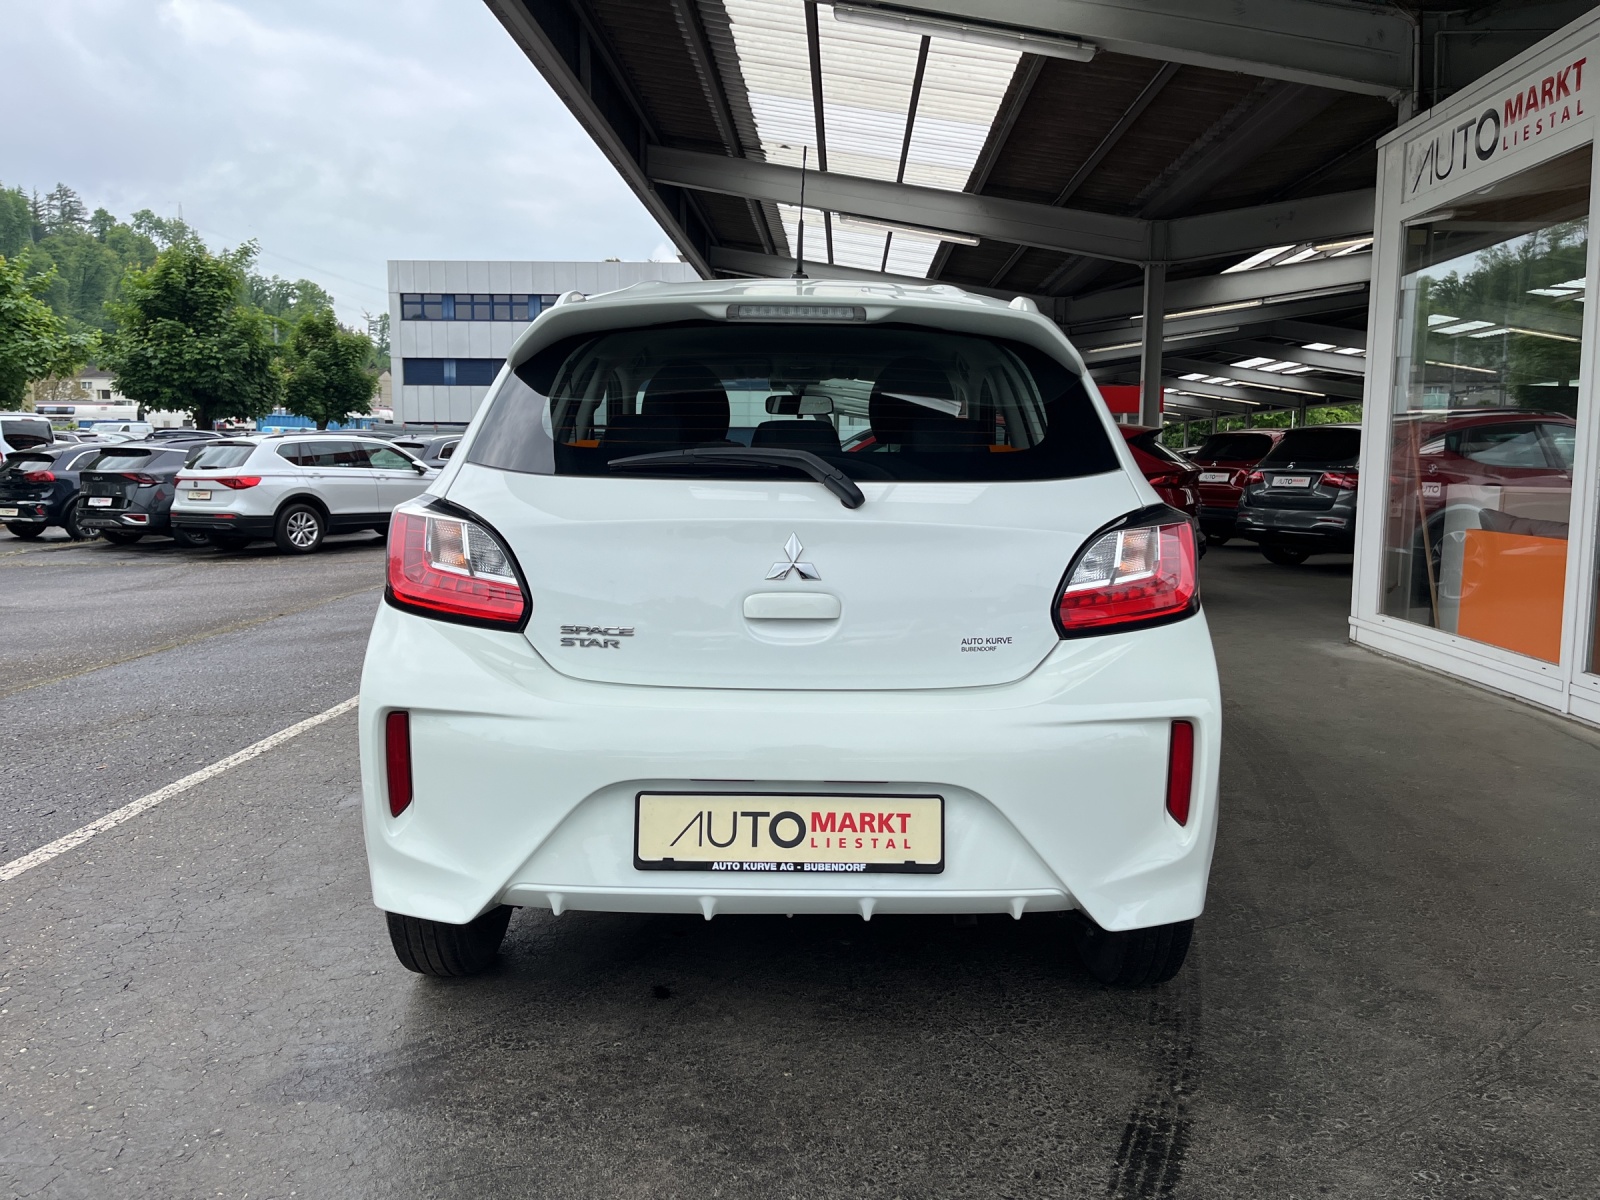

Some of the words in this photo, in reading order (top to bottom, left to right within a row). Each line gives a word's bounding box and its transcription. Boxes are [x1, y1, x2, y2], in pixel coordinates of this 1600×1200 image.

[1412, 108, 1501, 193] AUTO
[1503, 57, 1587, 128] MARKT
[1503, 99, 1584, 151] LIESTAL
[560, 625, 635, 637] SPACE
[560, 637, 620, 649] STAR
[669, 811, 806, 849] AUTO
[810, 811, 911, 834] MARKT
[810, 837, 911, 849] LIESTAL
[711, 862, 740, 871] AUTO
[742, 862, 777, 872] KURVE
[779, 863, 794, 872] AG
[803, 863, 867, 873] BUBENDORF
